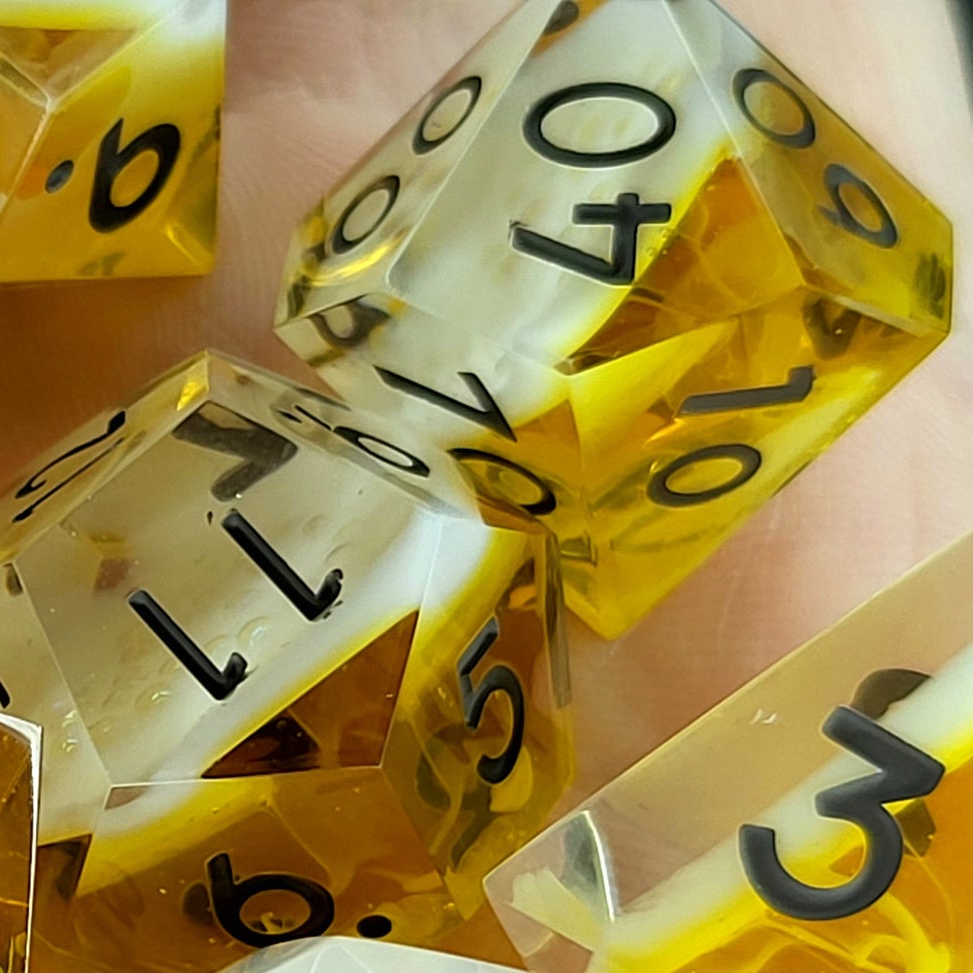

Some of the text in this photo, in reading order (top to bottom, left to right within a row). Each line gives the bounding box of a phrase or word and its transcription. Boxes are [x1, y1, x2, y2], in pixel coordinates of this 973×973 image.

[128, 508, 345, 702] 11
[457, 615, 526, 786] 5
[738, 704, 947, 922] 3
